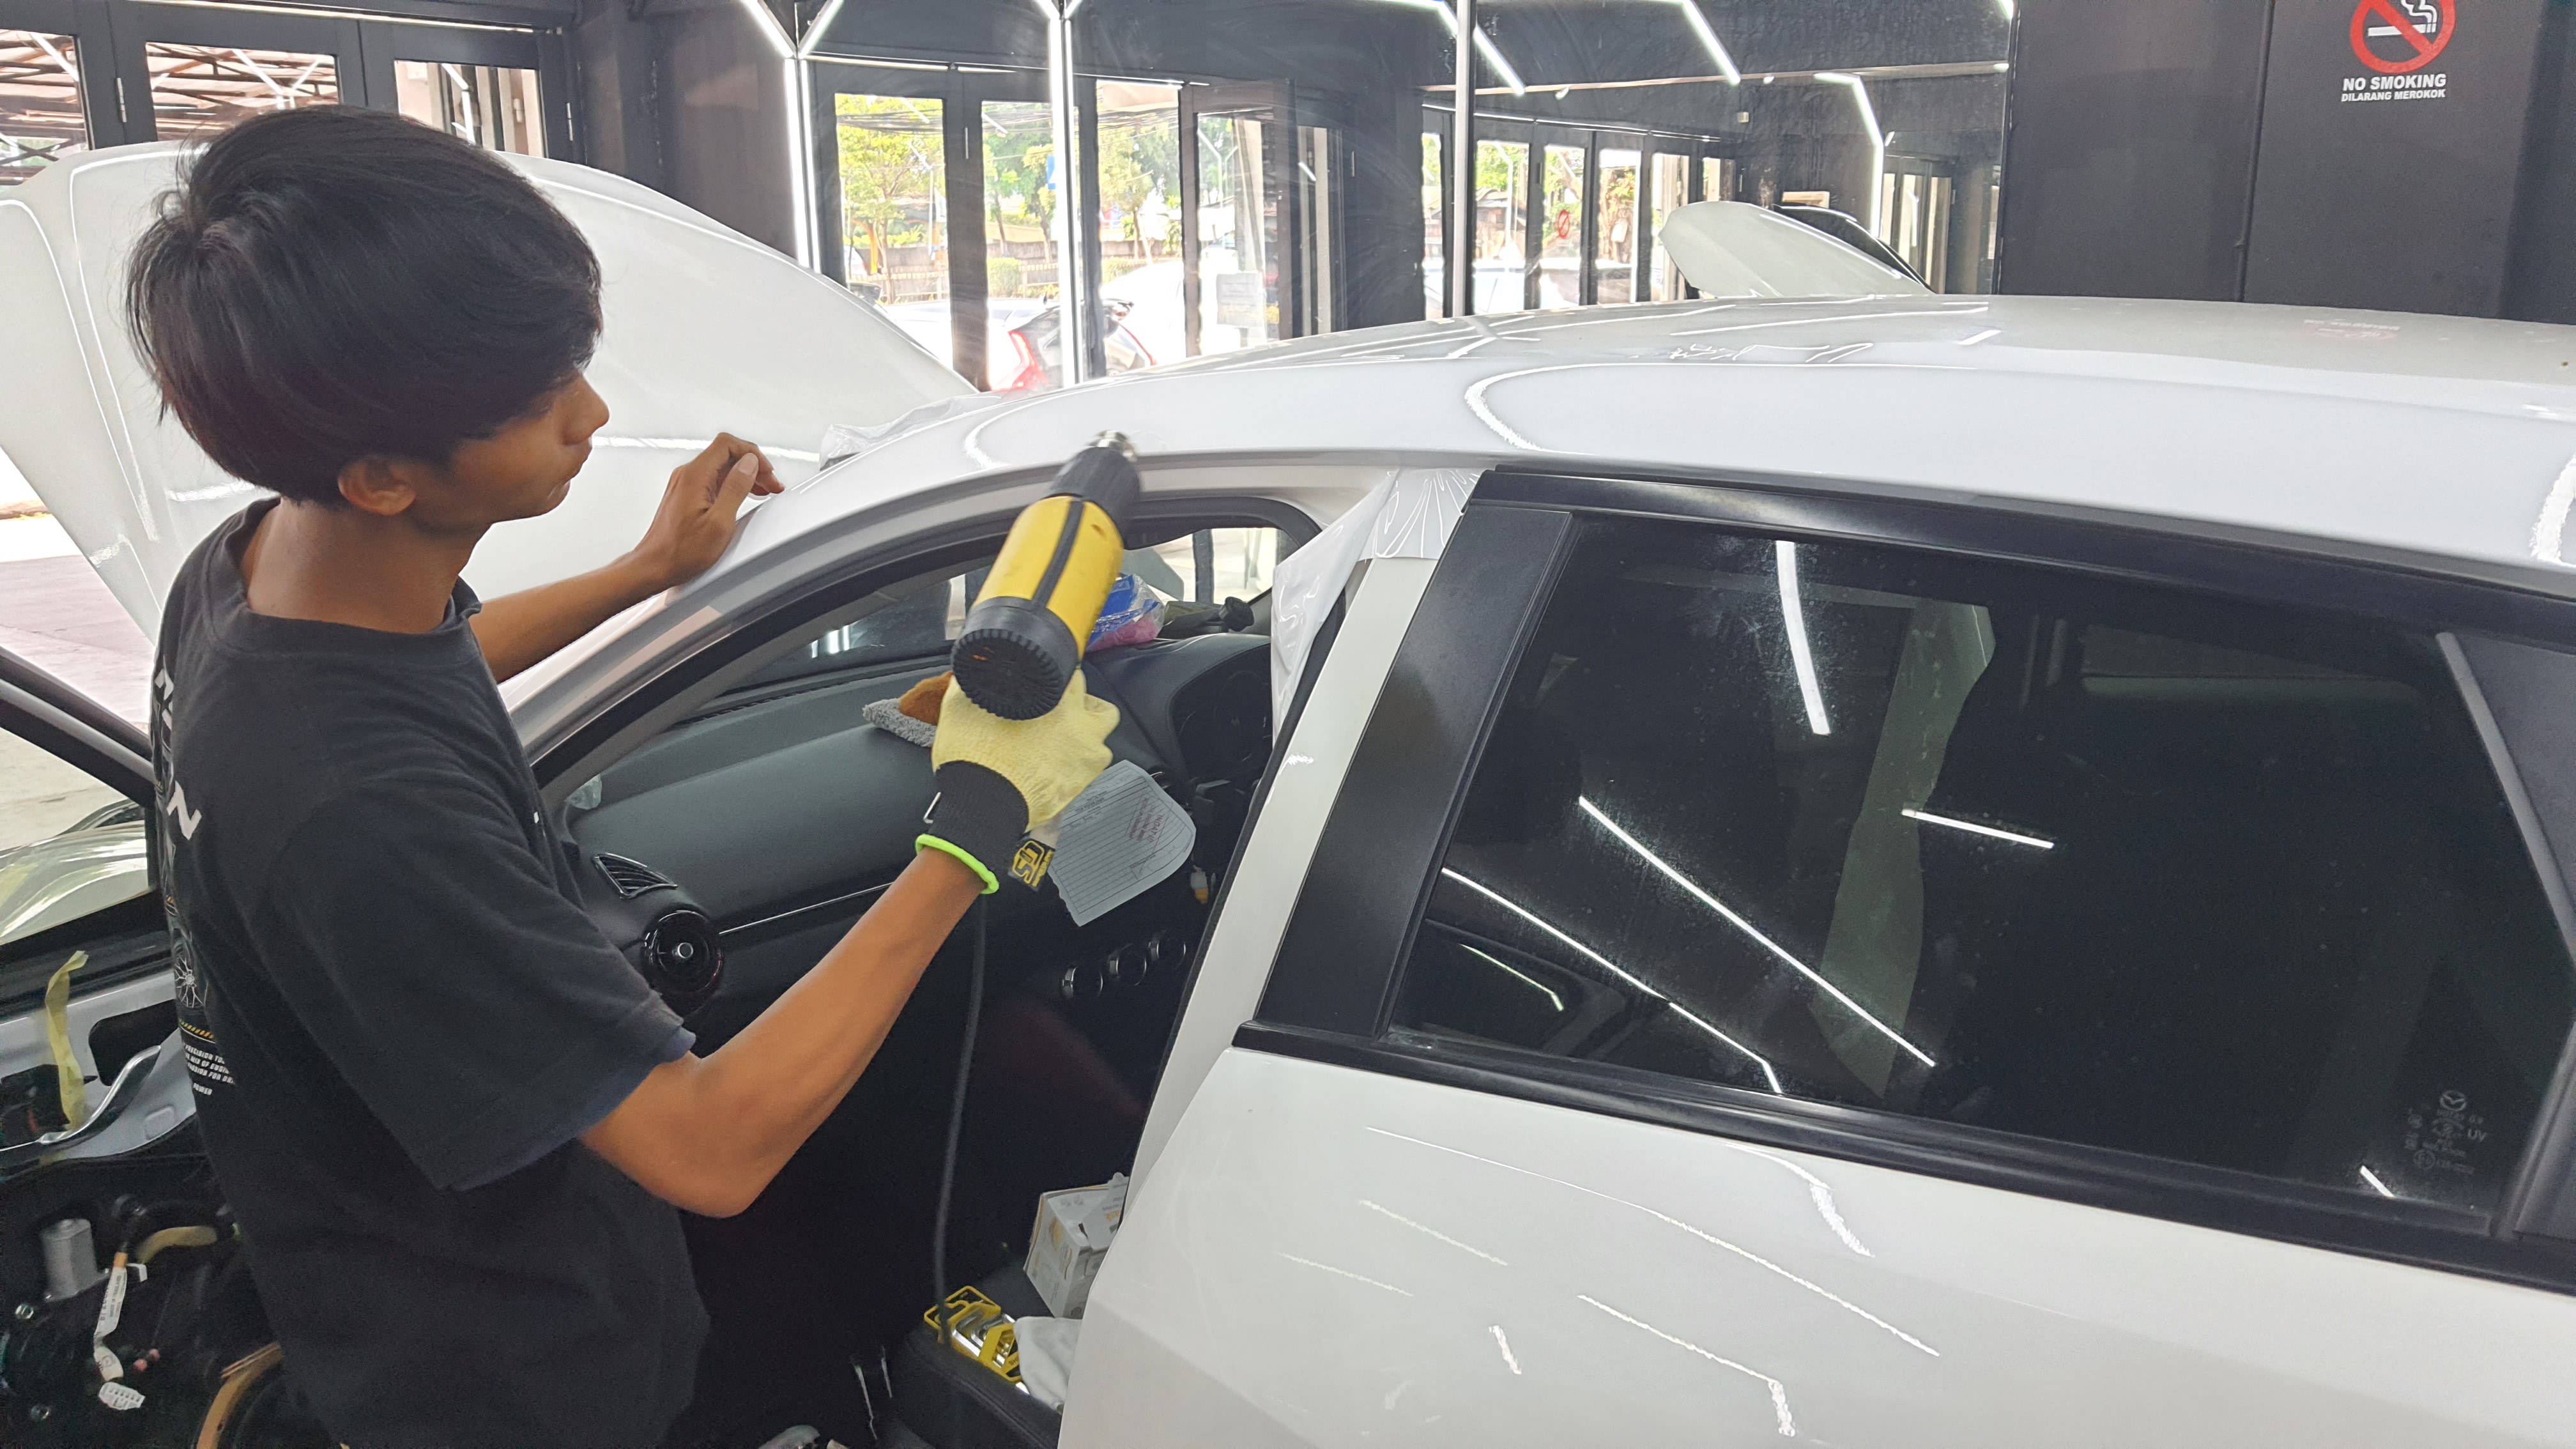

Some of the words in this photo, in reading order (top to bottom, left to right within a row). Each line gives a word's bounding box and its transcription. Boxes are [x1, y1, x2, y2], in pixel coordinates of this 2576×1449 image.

[2342, 78, 2366, 91] NO
[2370, 73, 2446, 90] SMOKING
[2341, 91, 2391, 102] DILARANG
[2394, 89, 2446, 100] MEROKOK
[1150, 813, 1163, 835] INGAT
[193, 1082, 212, 1096] POWER
